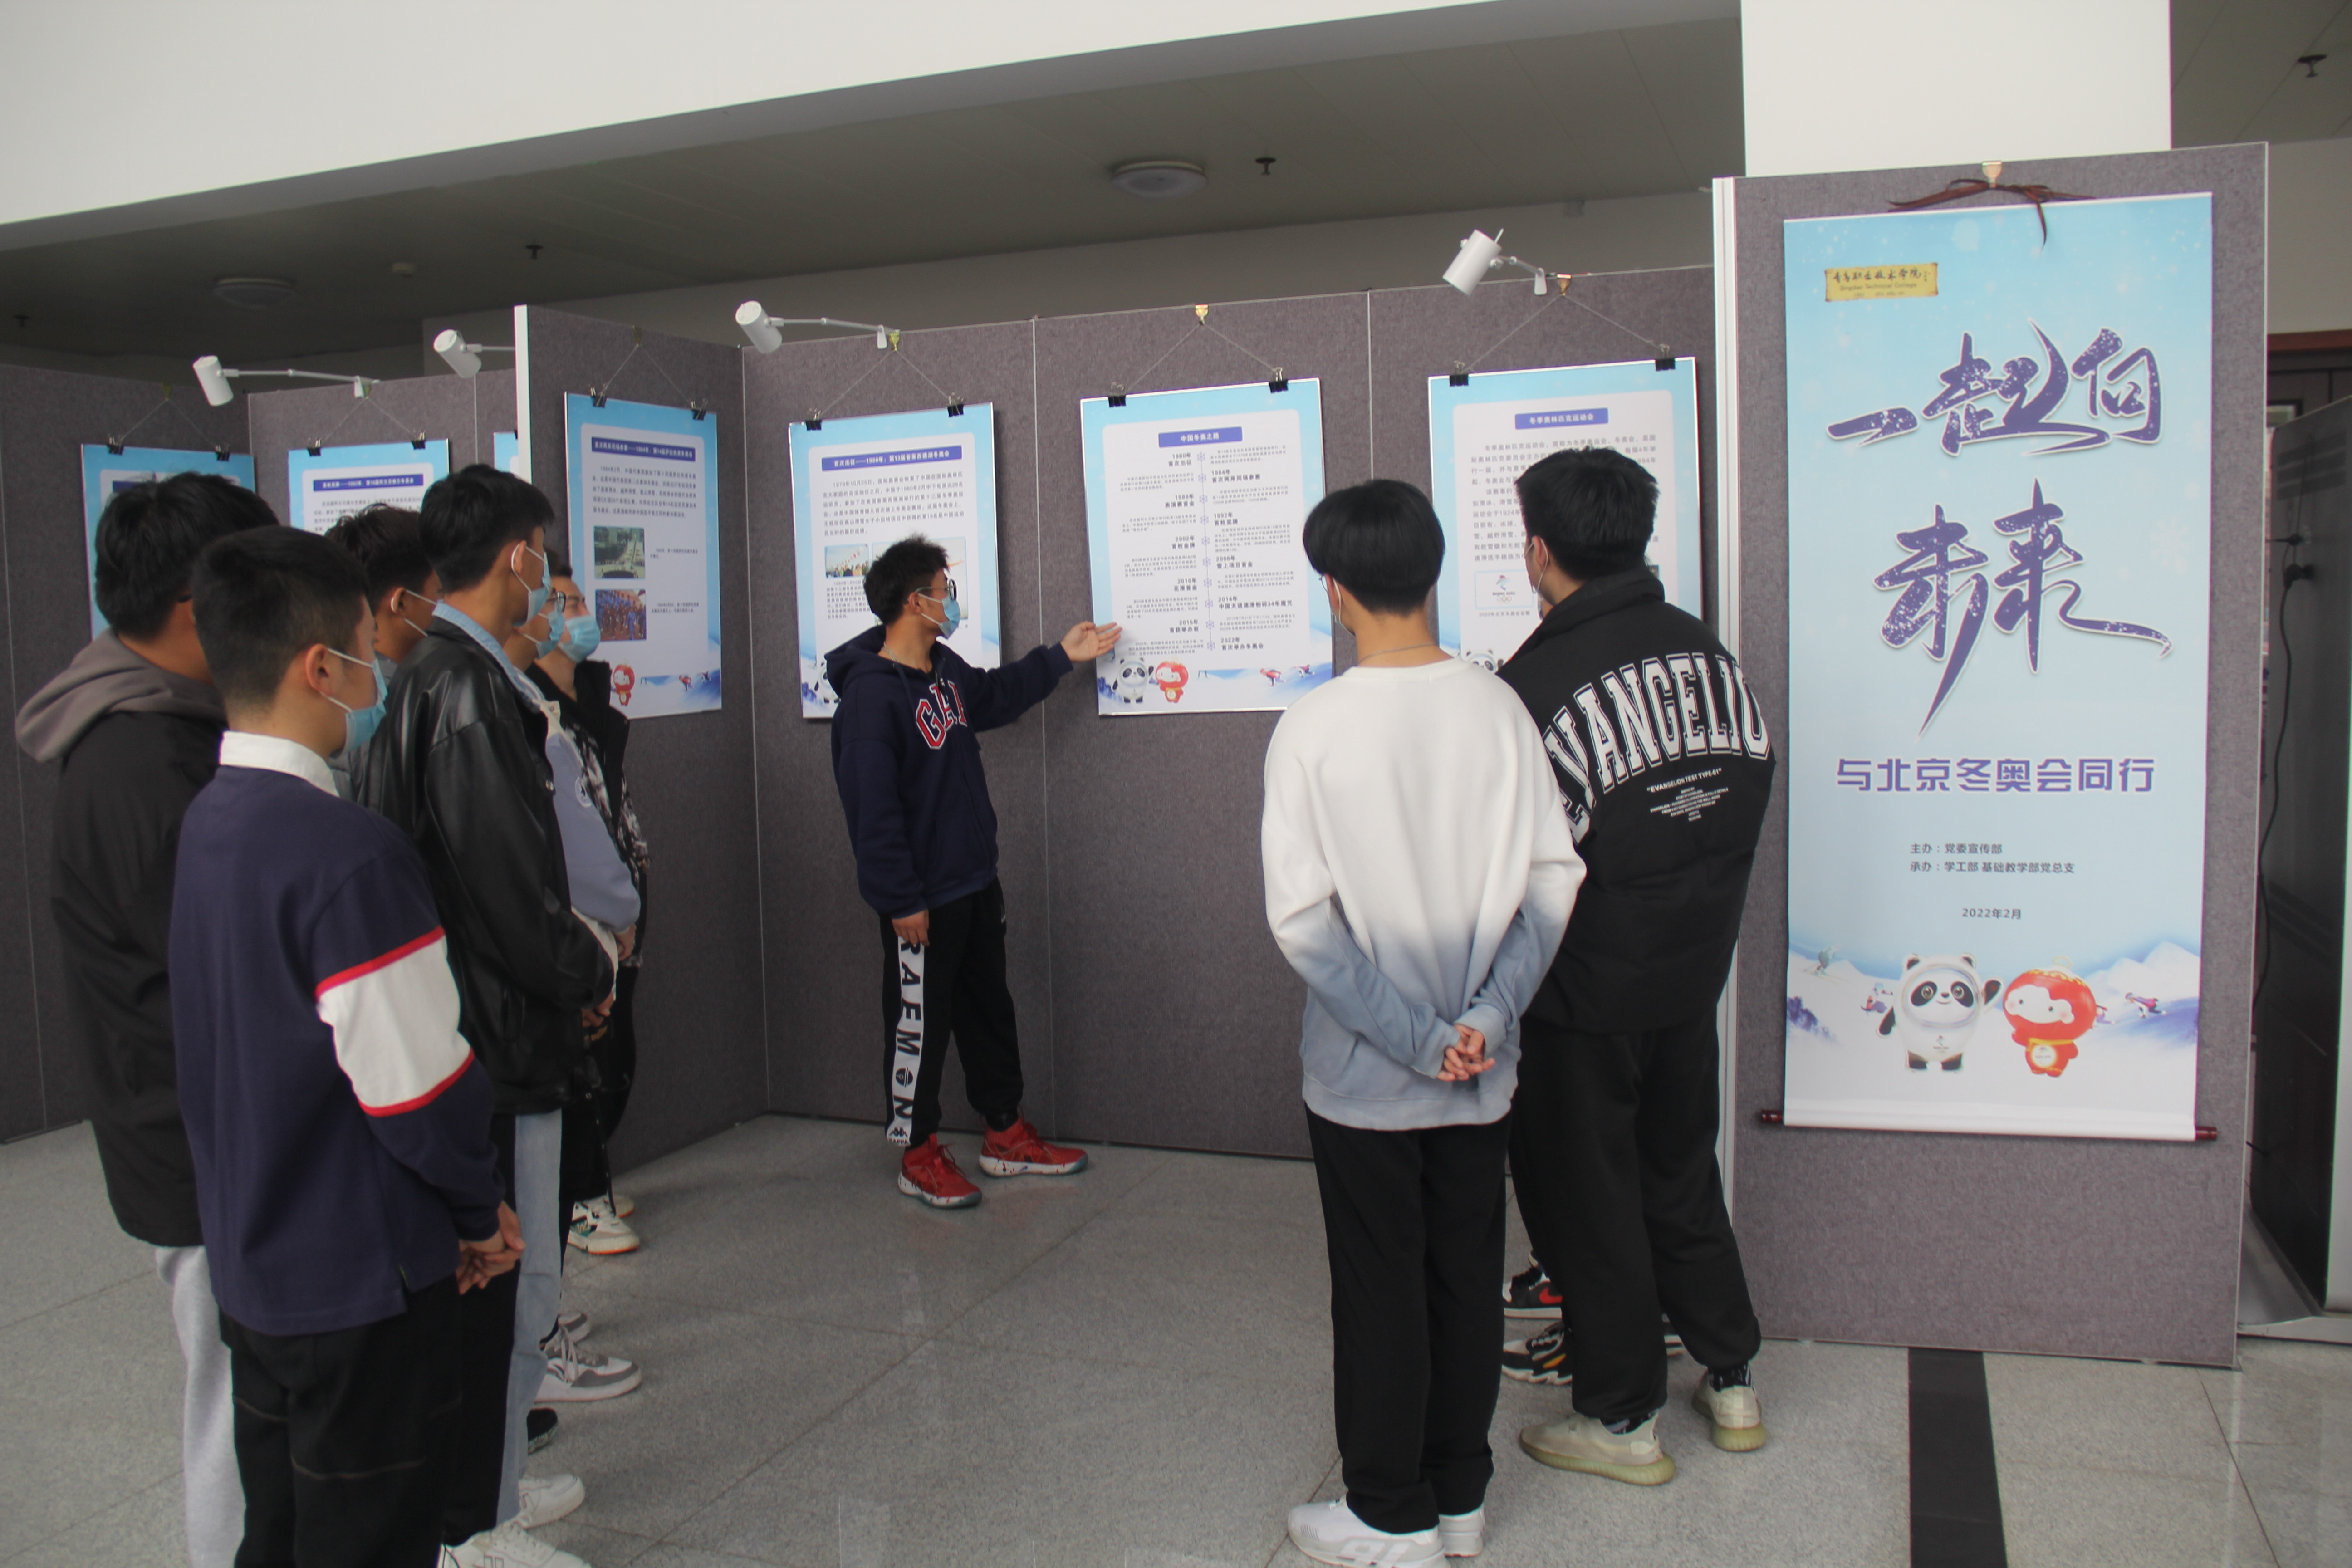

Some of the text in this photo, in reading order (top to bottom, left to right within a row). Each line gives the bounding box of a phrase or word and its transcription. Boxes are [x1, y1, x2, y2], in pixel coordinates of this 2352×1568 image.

[1529, 413, 1594, 425] 冬季奥林匹克运动会
[1181, 432, 1220, 442] 中国冬奥之路
[1543, 652, 1769, 845] VANGELIO
[1686, 774, 1698, 783] TEST
[1837, 758, 2155, 792] 与北京冬奥会同行
[1910, 842, 2003, 855] 主办：党委宣传部
[1981, 861, 2075, 874] 基础教学部党总支
[1961, 908, 2022, 920] 2022年2月
